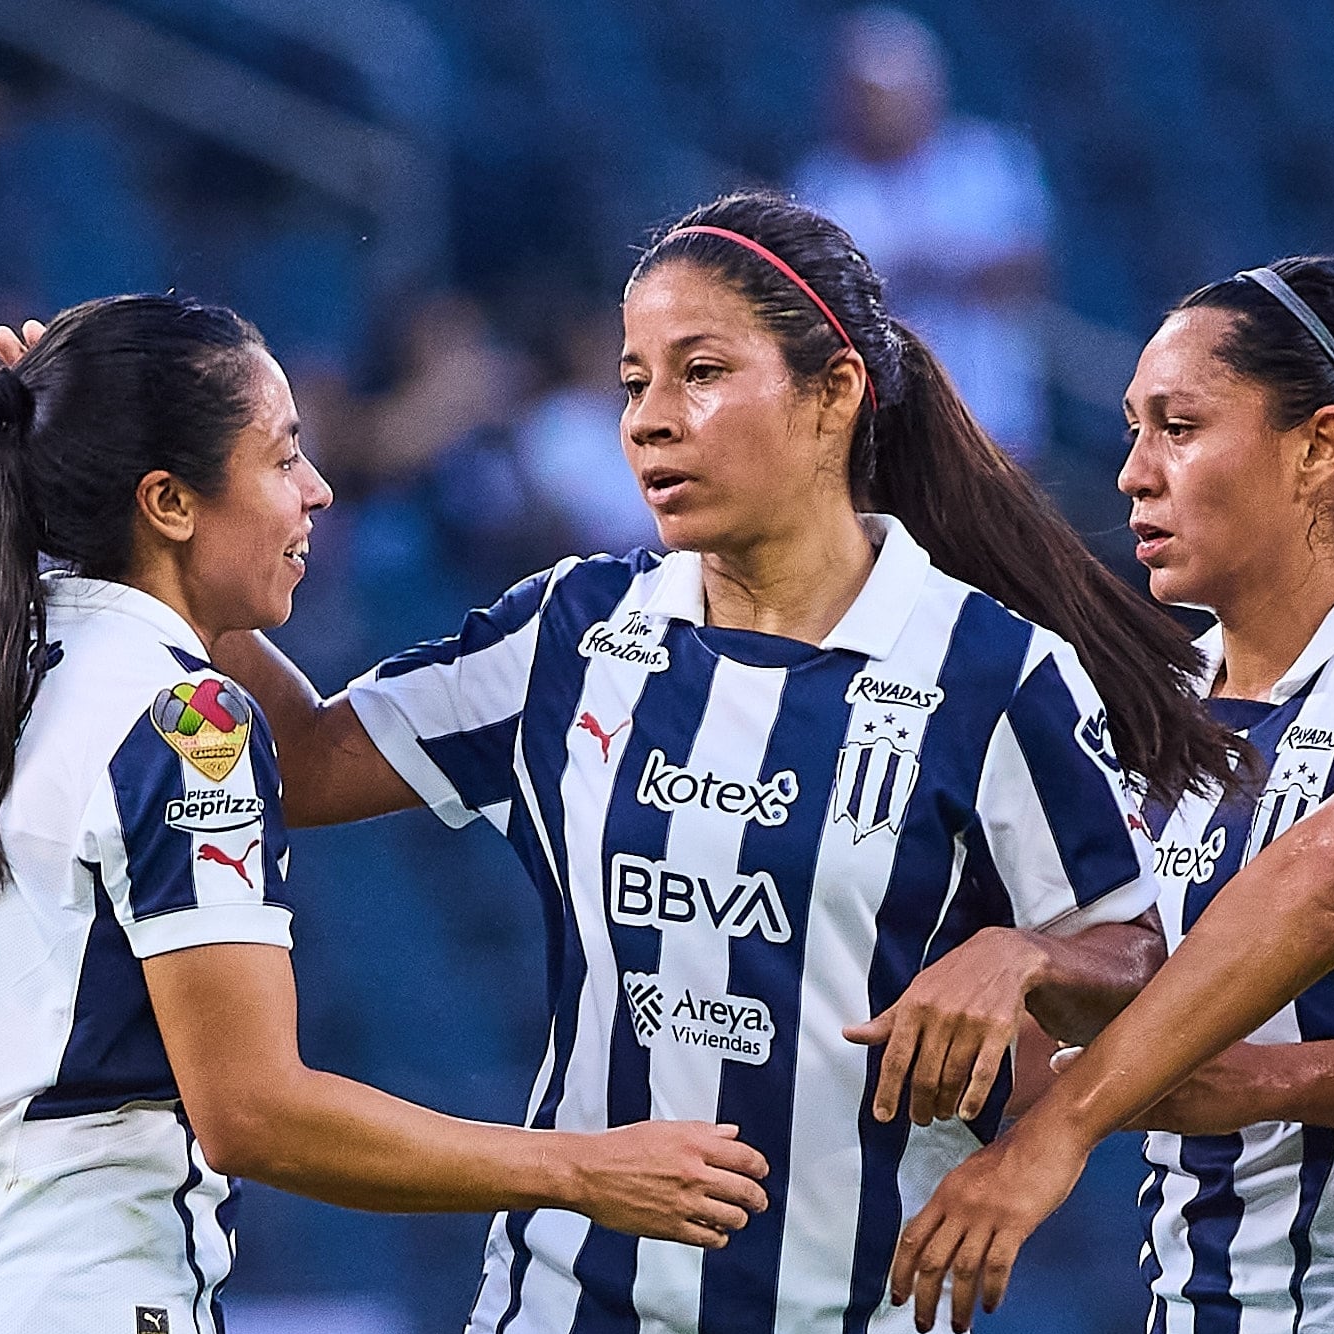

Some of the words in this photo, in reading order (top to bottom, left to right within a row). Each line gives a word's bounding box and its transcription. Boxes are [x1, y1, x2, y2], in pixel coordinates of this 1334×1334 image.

[620, 610, 652, 637] Tim
[856, 676, 938, 708] RAYADAS
[187, 788, 225, 801] Pizza
[643, 755, 773, 820] kotex
[617, 863, 783, 934] BBVA
[671, 1024, 761, 1056] Viviendas
